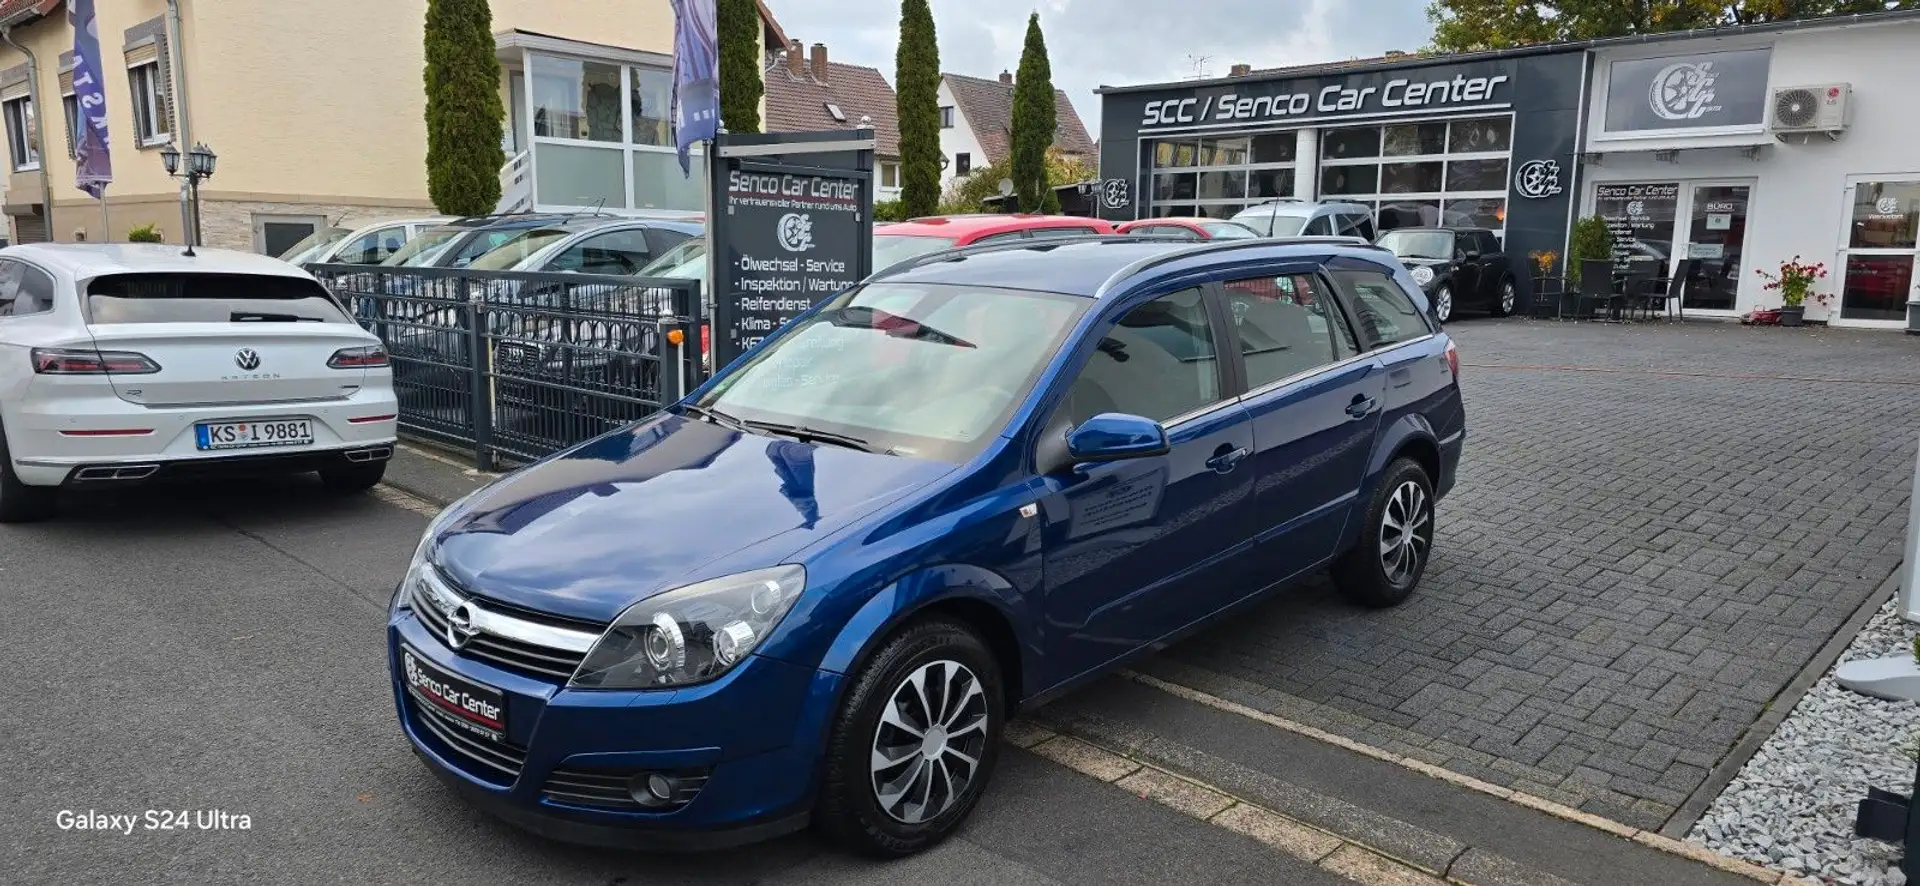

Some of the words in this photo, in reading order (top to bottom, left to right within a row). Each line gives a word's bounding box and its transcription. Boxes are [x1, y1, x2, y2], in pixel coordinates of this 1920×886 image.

[1142, 97, 1198, 125] SCC
[1200, 96, 1214, 121] /
[1215, 93, 1310, 120] Senco
[1318, 85, 1377, 112] Car
[1381, 75, 1508, 107] Center
[729, 170, 778, 194] Senco
[781, 174, 808, 196] Car
[811, 176, 859, 200] Center
[1598, 186, 1627, 196] Senco
[1628, 185, 1645, 195] Car
[1645, 184, 1679, 195] Center
[729, 195, 739, 205] Ihr
[791, 199, 814, 210] Partner
[814, 201, 830, 210] rund
[843, 204, 857, 212] Auto
[741, 254, 798, 272] Ölwechsel
[806, 258, 845, 273] Service
[741, 277, 801, 294] Inspektion
[741, 297, 811, 311] Reifendienst
[741, 317, 771, 331] Klima
[210, 425, 236, 442] KS
[251, 424, 260, 441] I
[264, 422, 311, 440] 9881
[417, 668, 442, 696] Senco
[443, 684, 460, 705] Car
[462, 692, 500, 721] Center
